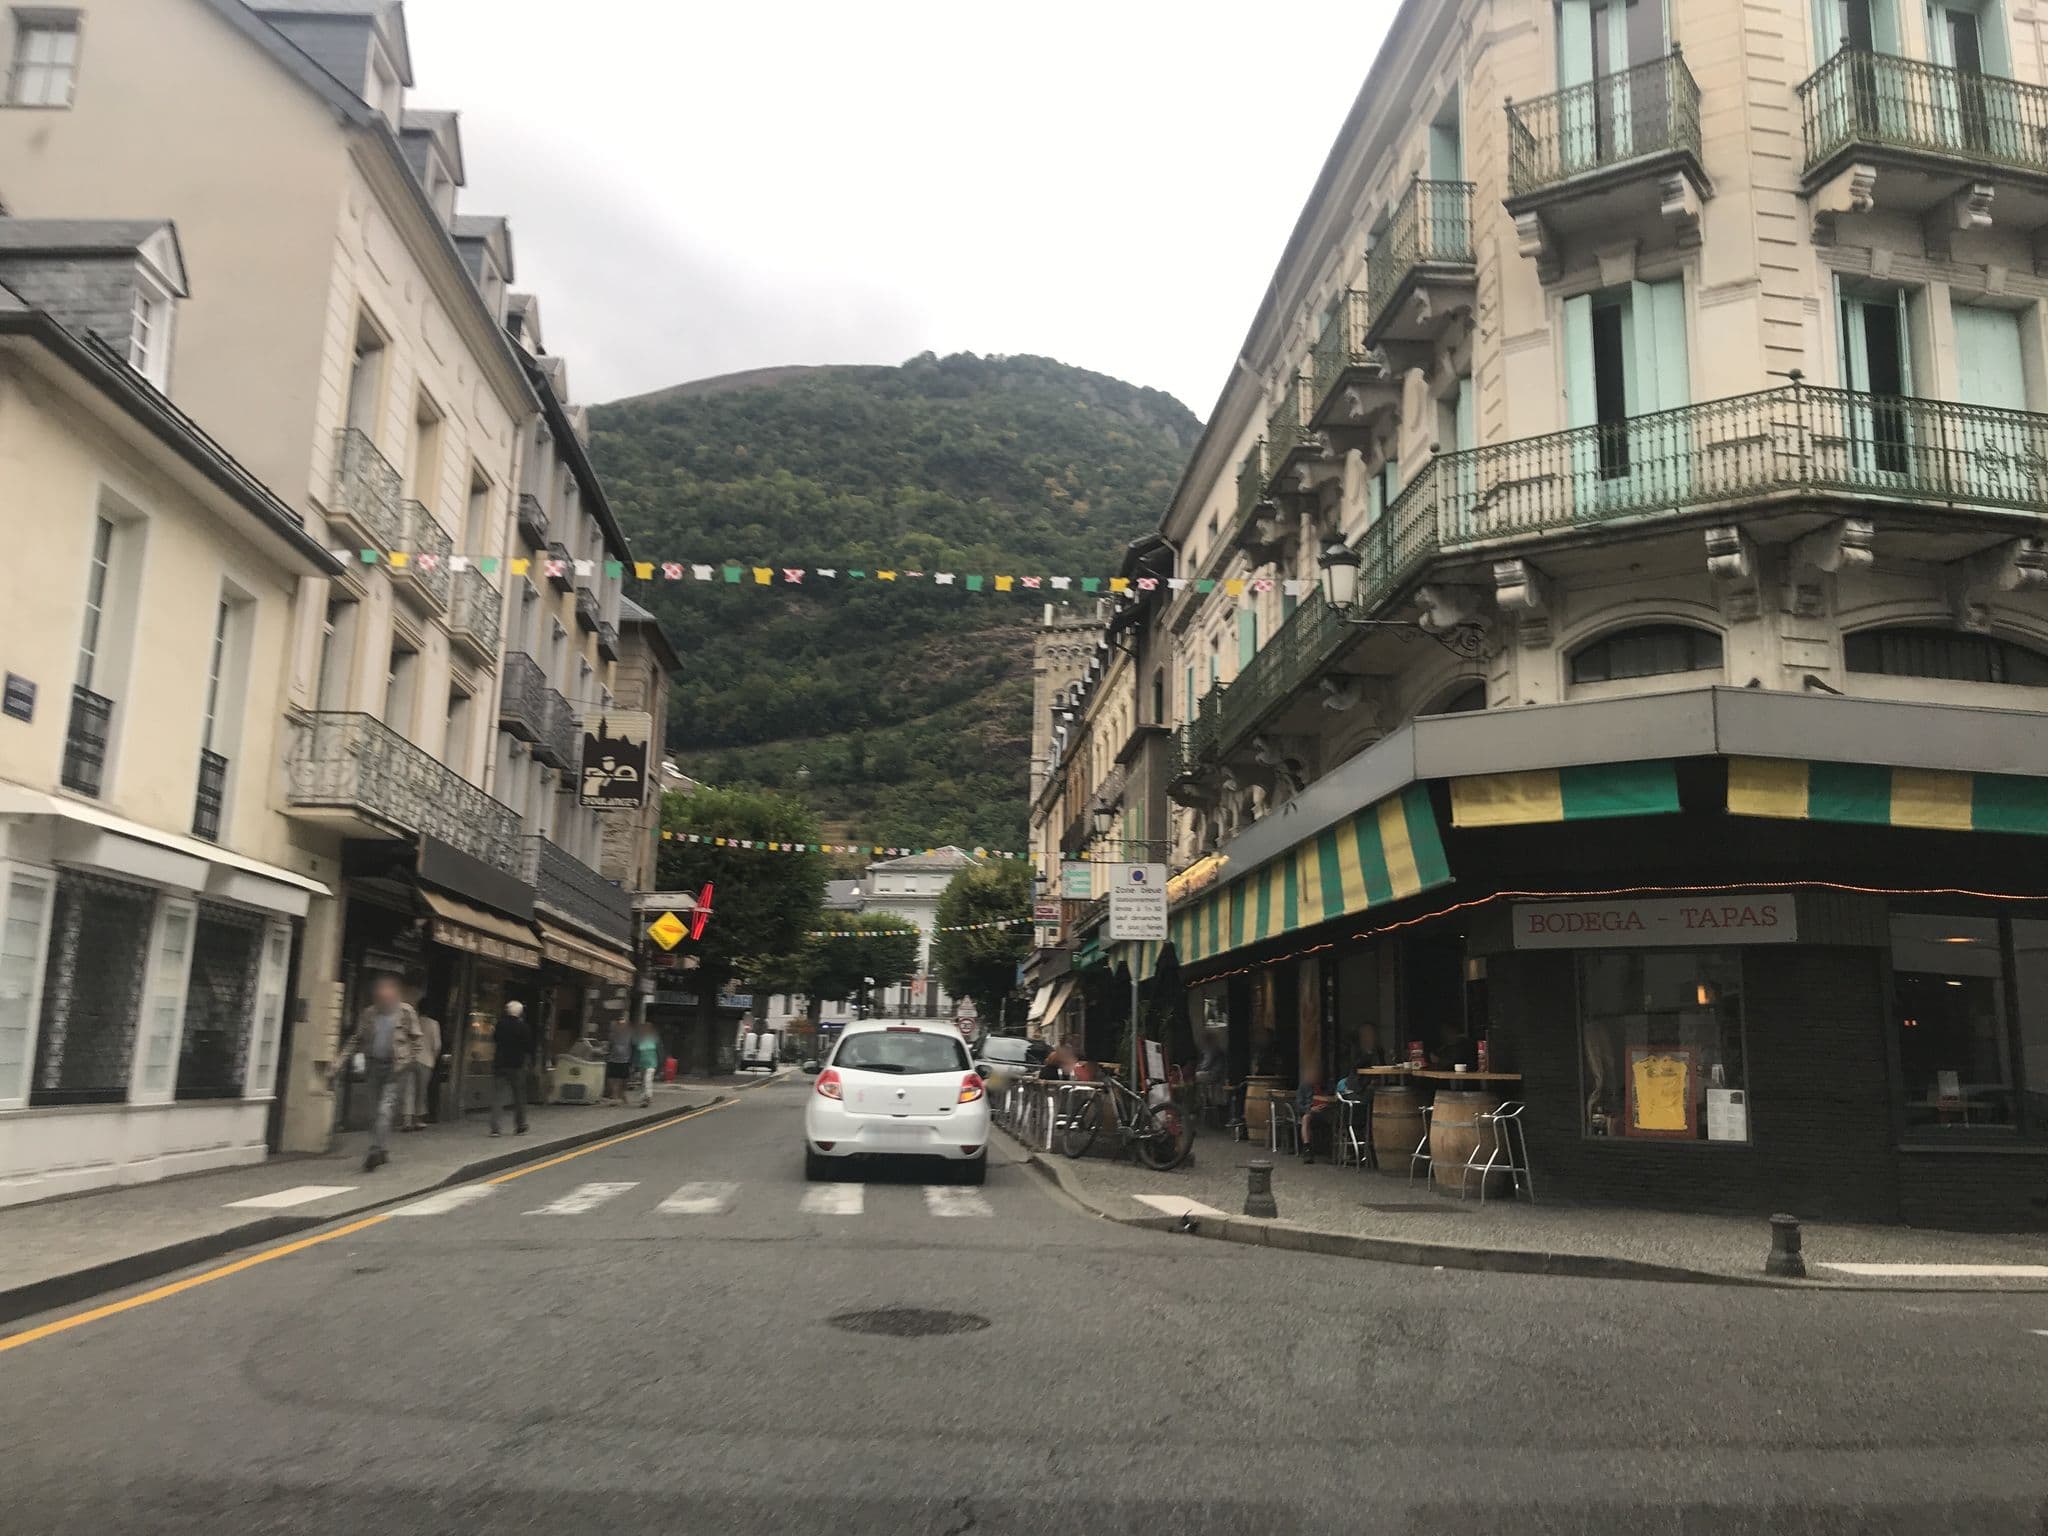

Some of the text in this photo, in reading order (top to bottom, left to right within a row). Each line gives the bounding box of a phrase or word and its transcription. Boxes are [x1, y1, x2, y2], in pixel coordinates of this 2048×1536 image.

[1115, 886, 1162, 894] Zone bleue
[1528, 911, 1646, 934] BODEGA
[1680, 905, 1778, 929] TAPAS
